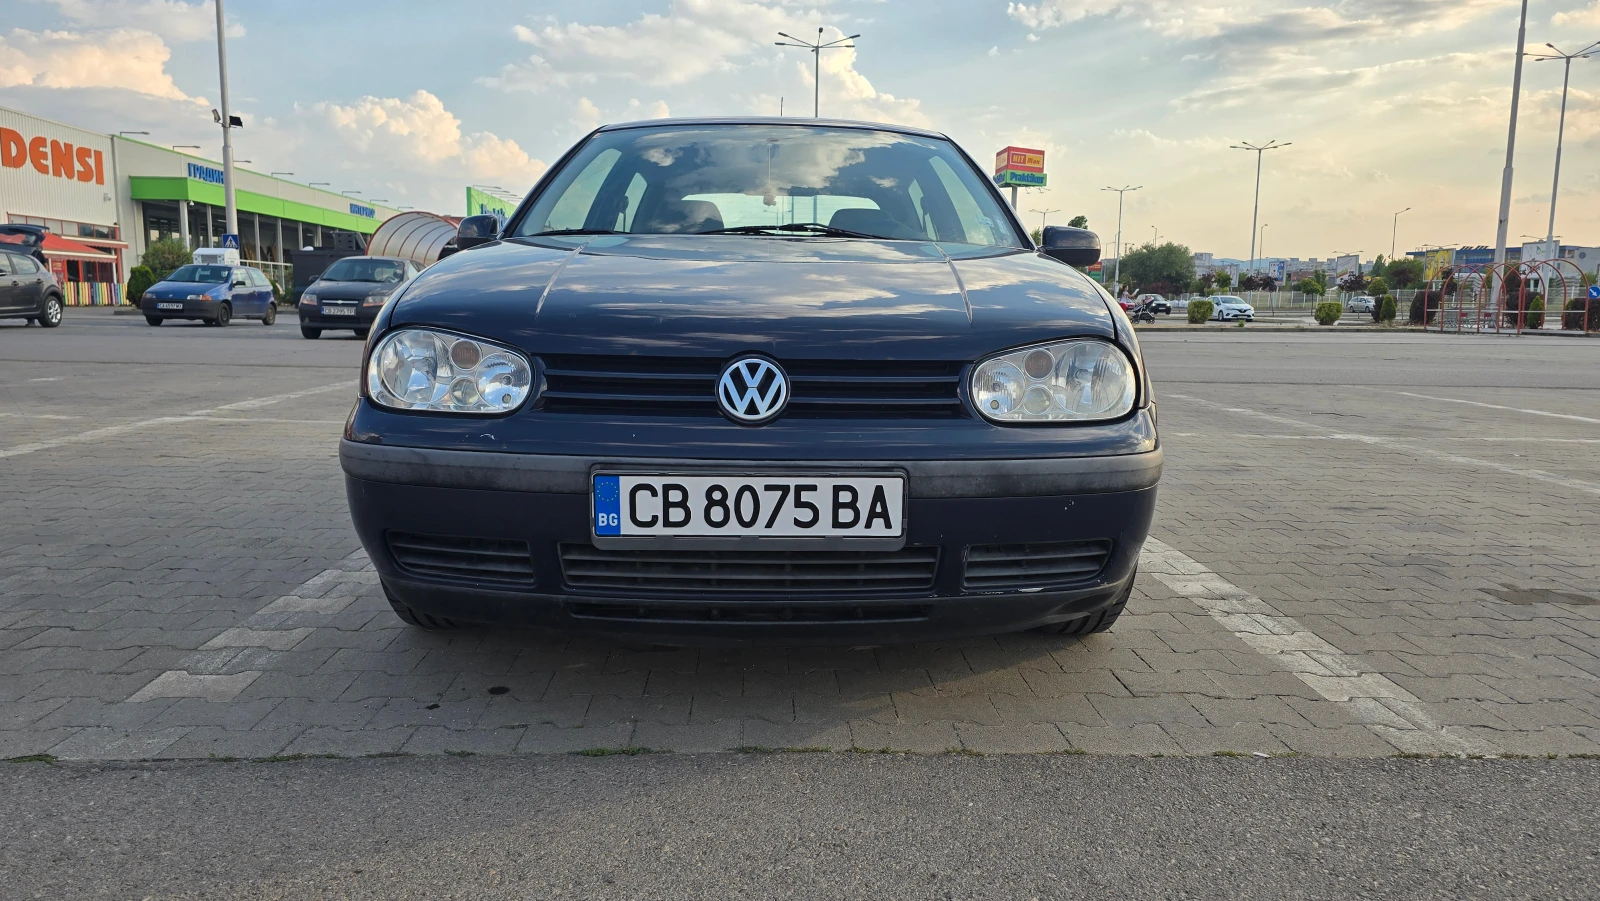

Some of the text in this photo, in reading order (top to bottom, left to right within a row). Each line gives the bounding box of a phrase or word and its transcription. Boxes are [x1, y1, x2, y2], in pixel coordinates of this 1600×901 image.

[0, 126, 105, 186] DENSI
[1012, 155, 1025, 163] HIT
[1010, 171, 1044, 184] Praktiker
[719, 358, 787, 420] VW
[598, 512, 618, 526] BG
[629, 483, 893, 529] CB 8075 BA
